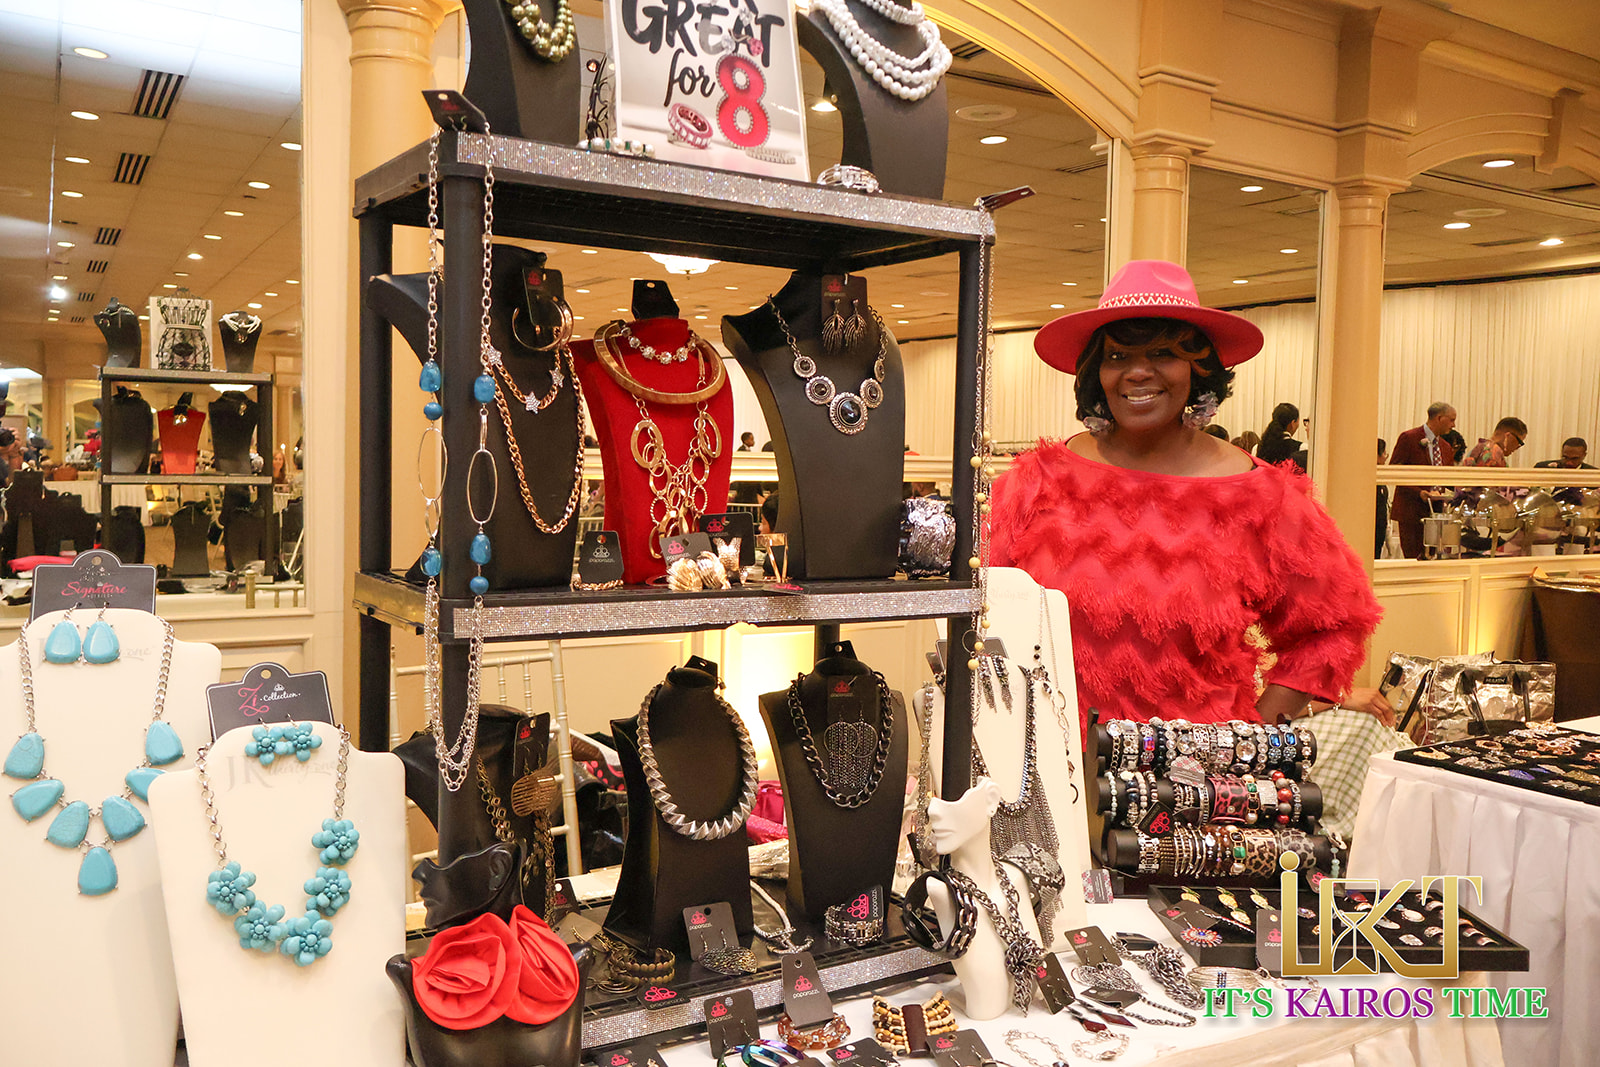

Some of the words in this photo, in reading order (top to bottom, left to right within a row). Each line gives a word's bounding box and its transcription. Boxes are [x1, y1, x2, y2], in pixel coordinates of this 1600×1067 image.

[622, 0, 785, 68] GREAT
[664, 48, 715, 107] for
[716, 53, 771, 150] 8
[61, 581, 127, 598] Signature
[263, 691, 299, 702] Collection
